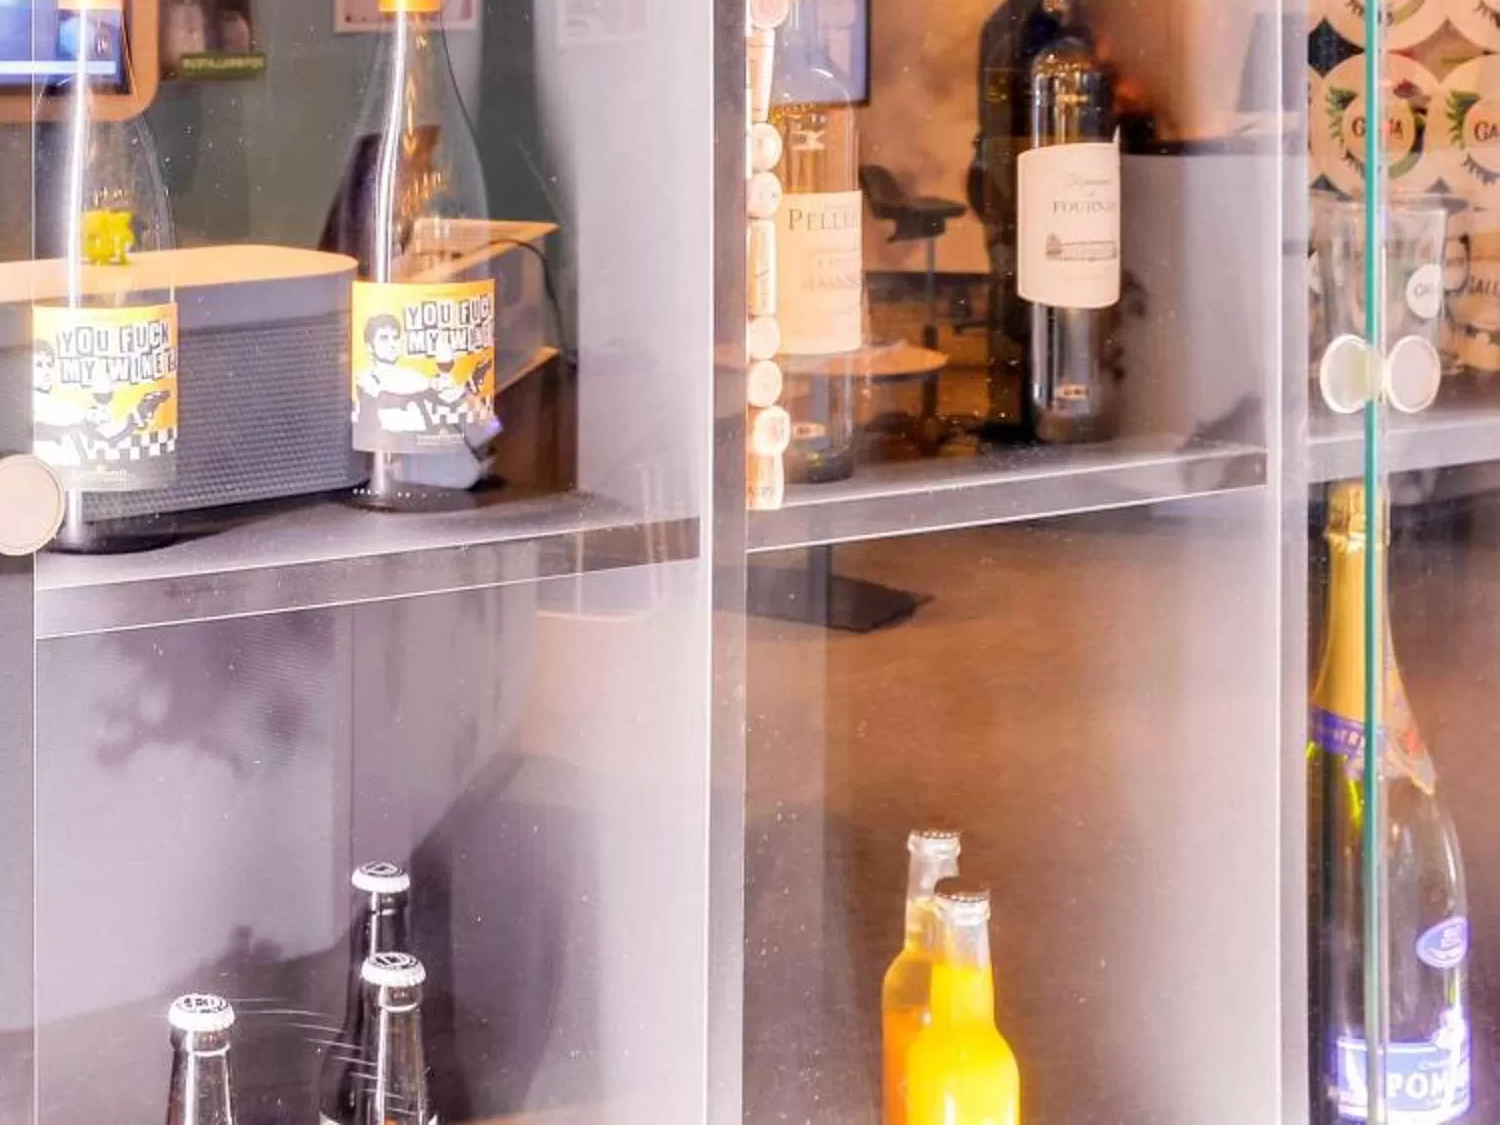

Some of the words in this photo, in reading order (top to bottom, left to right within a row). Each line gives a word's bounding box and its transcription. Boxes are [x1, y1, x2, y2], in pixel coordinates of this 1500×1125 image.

[406, 301, 452, 328] YOU
[60, 327, 109, 356] YOU
[119, 320, 169, 353] FUCK
[408, 330, 439, 354] MY
